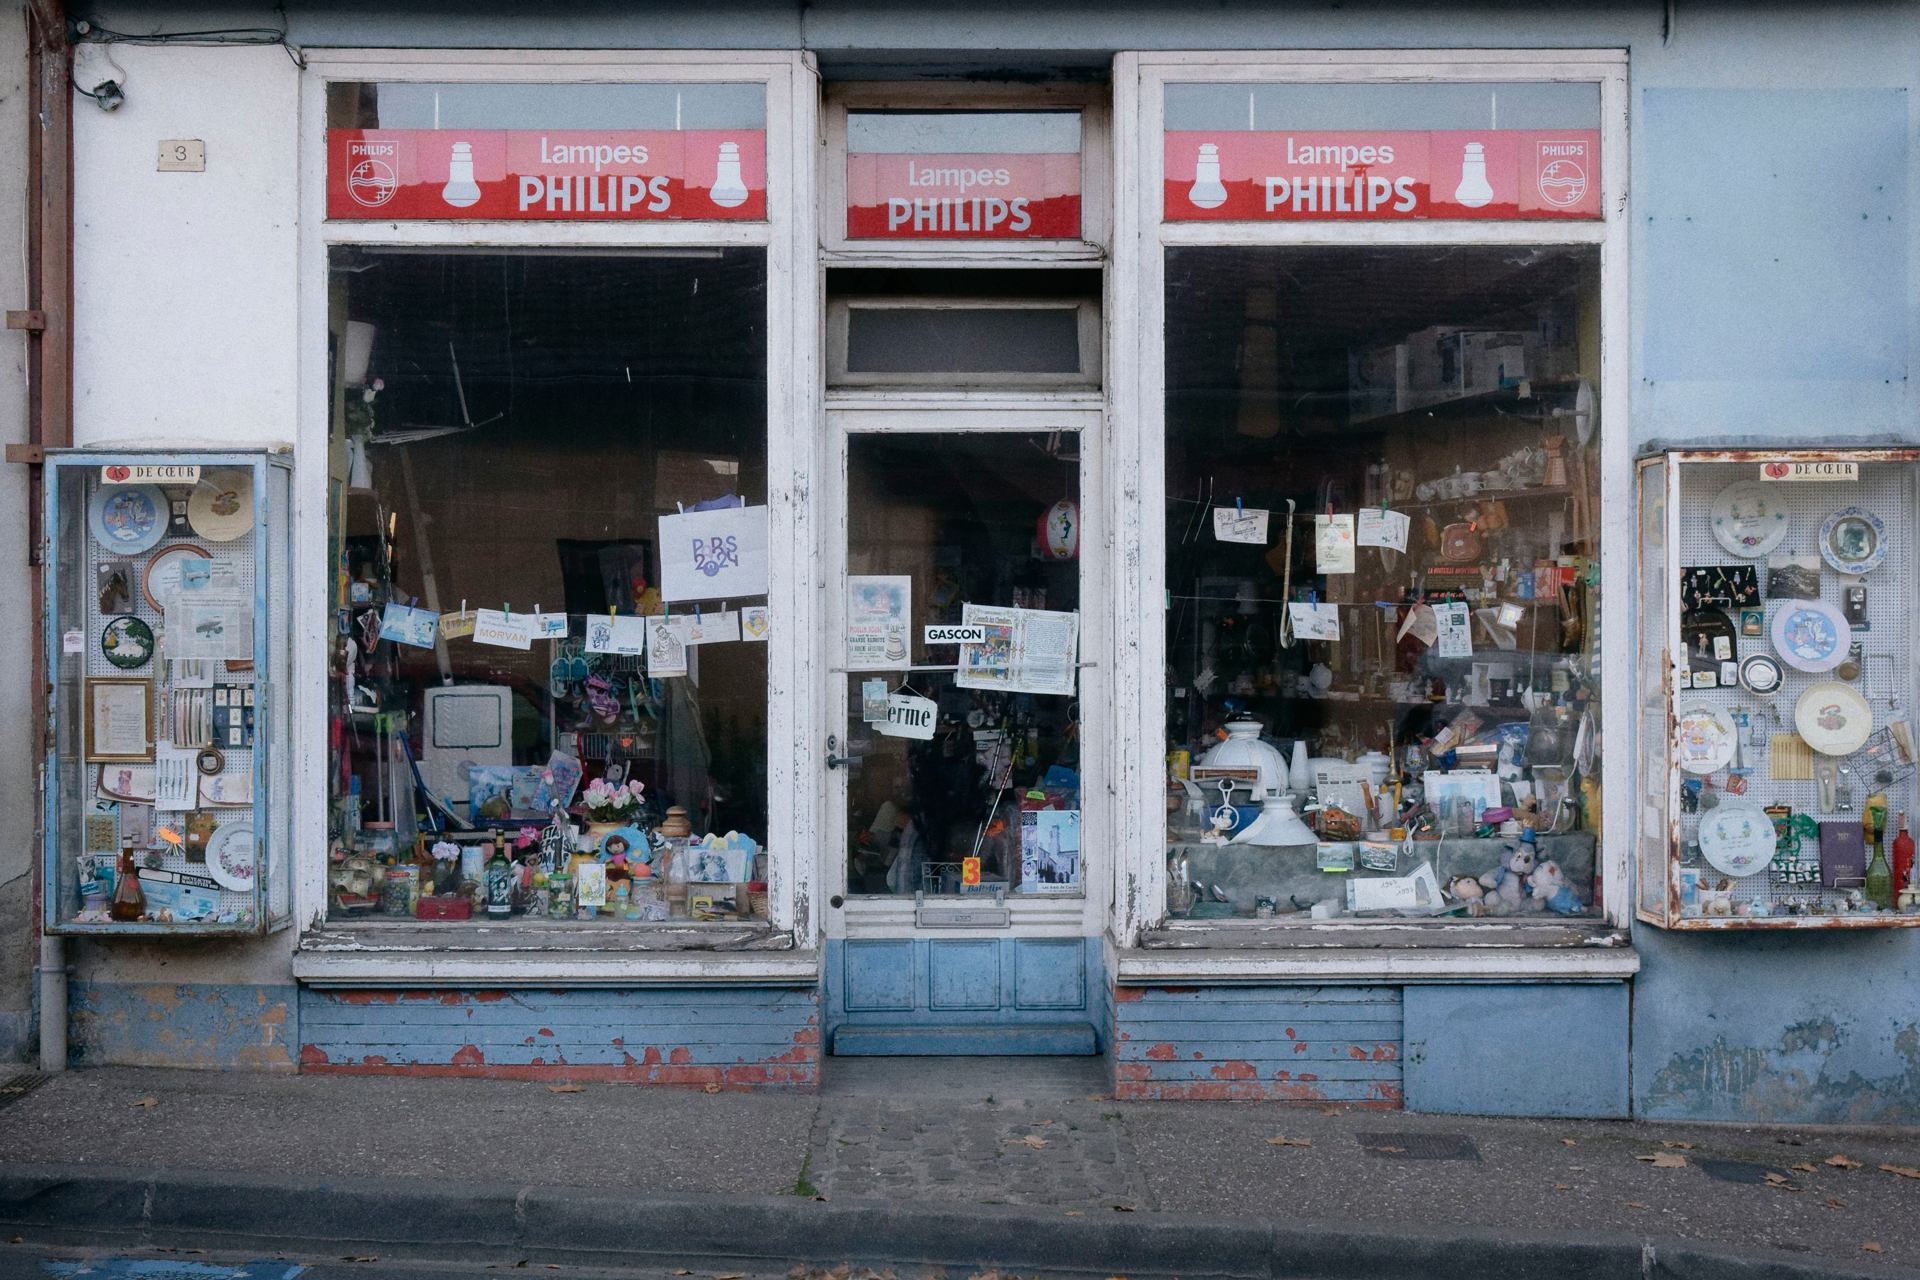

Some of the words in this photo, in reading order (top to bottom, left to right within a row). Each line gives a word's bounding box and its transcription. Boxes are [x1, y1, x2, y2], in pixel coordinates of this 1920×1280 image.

[175, 145, 187, 161] 3
[352, 145, 394, 156] PHILIPS
[540, 137, 649, 171] Lampes
[1286, 137, 1395, 171] Lampes
[1542, 145, 1584, 156] PHILIPS
[909, 160, 1012, 194] Lampes
[519, 176, 671, 213] PHILIPS
[1265, 176, 1417, 213] PHILIPS
[888, 197, 1031, 232] PHILIPS
[137, 467, 152, 477] DE
[1795, 464, 1811, 474] DE
[479, 628, 527, 643] MORVAN
[928, 629, 982, 640] GASCON
[887, 706, 931, 728] ermé
[964, 858, 980, 885] 3
